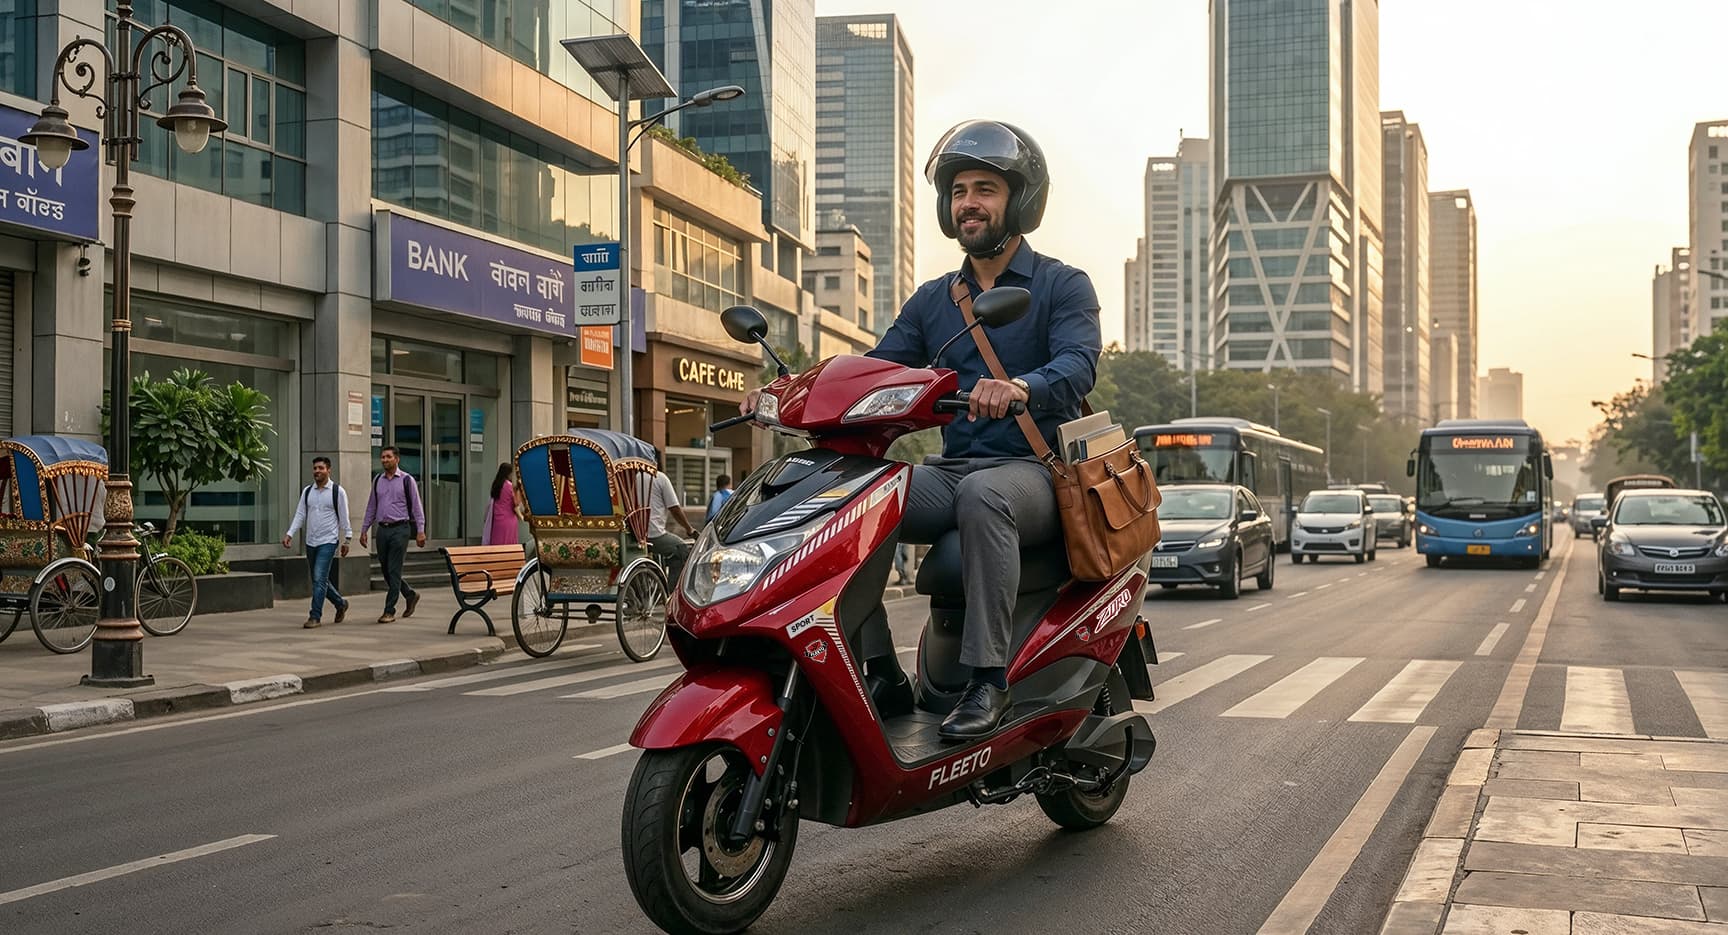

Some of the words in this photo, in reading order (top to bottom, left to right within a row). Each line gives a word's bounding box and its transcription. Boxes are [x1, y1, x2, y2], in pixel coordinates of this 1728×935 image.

[407, 240, 469, 282] BANK
[679, 358, 716, 386] CAFE
[791, 614, 815, 633] SPORT
[928, 746, 992, 790] FLEETO
